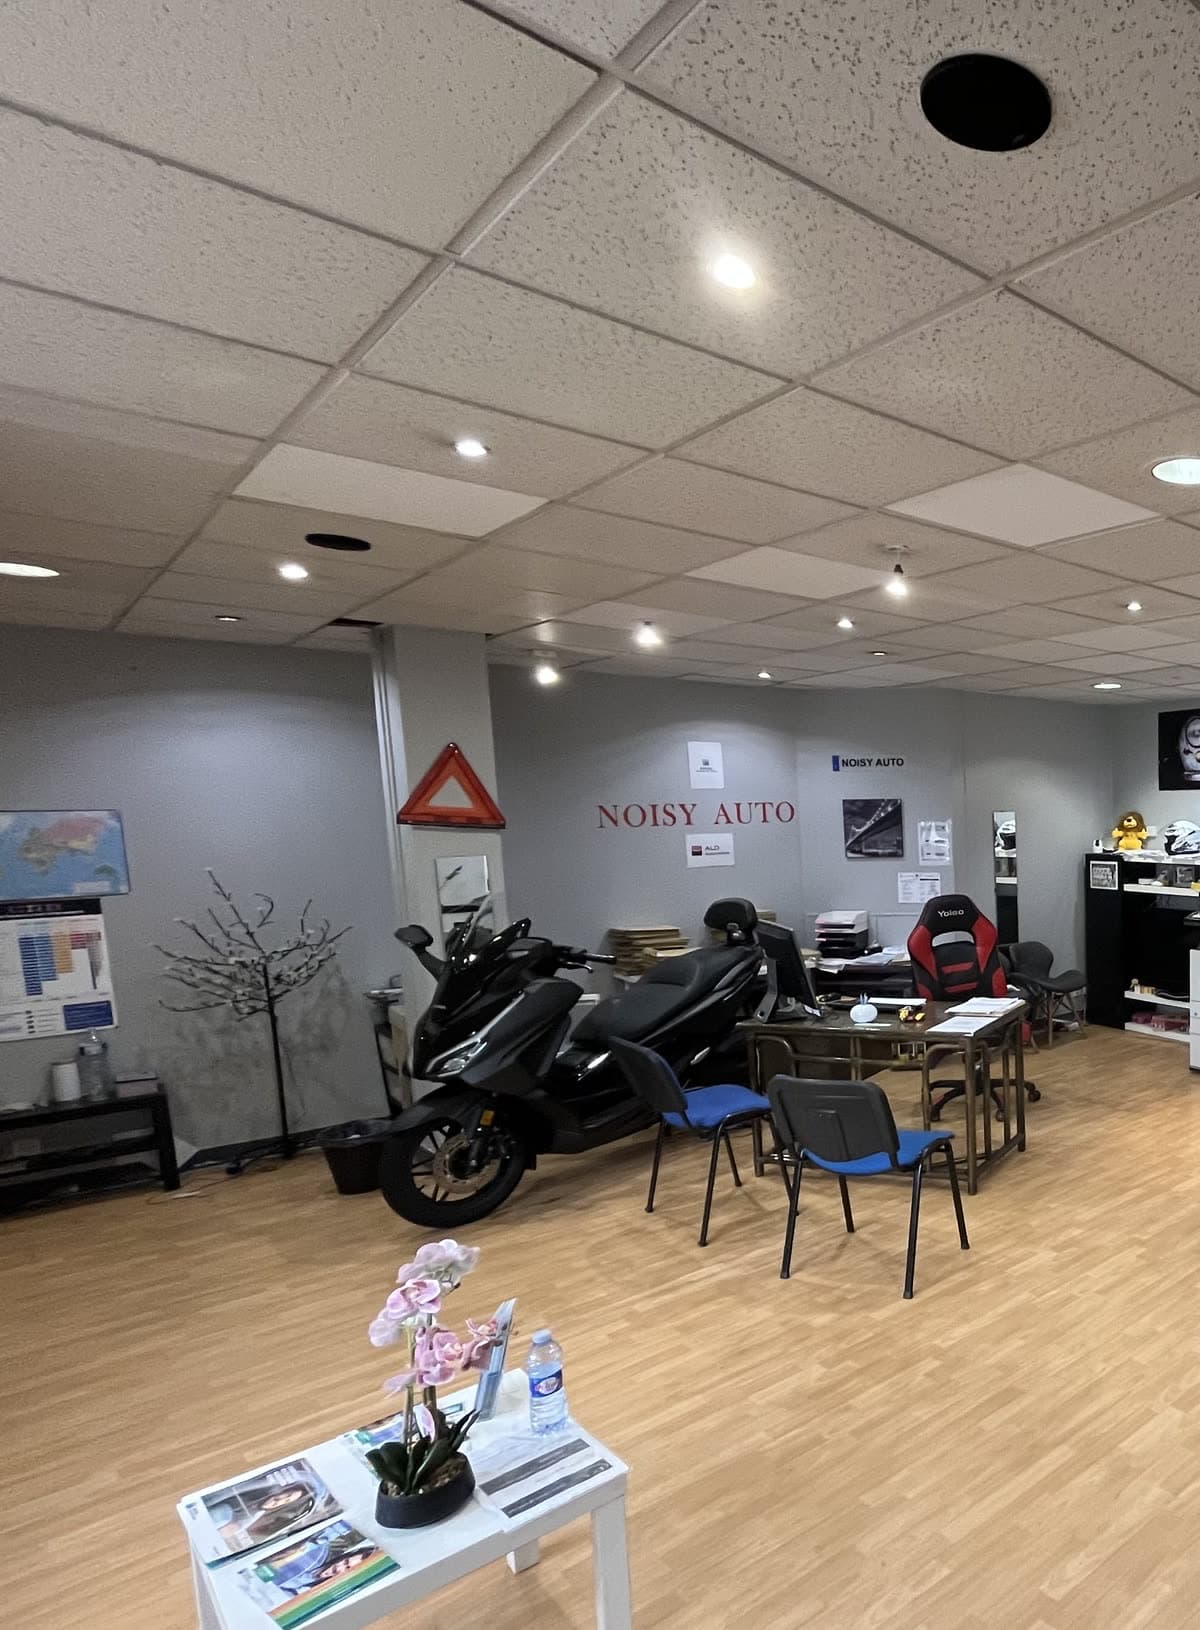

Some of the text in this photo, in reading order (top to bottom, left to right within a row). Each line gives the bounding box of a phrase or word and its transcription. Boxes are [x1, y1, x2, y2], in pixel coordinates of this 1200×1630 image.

[841, 757, 905, 767] NOISY AUTO
[597, 801, 796, 829] NOISY AUTO
